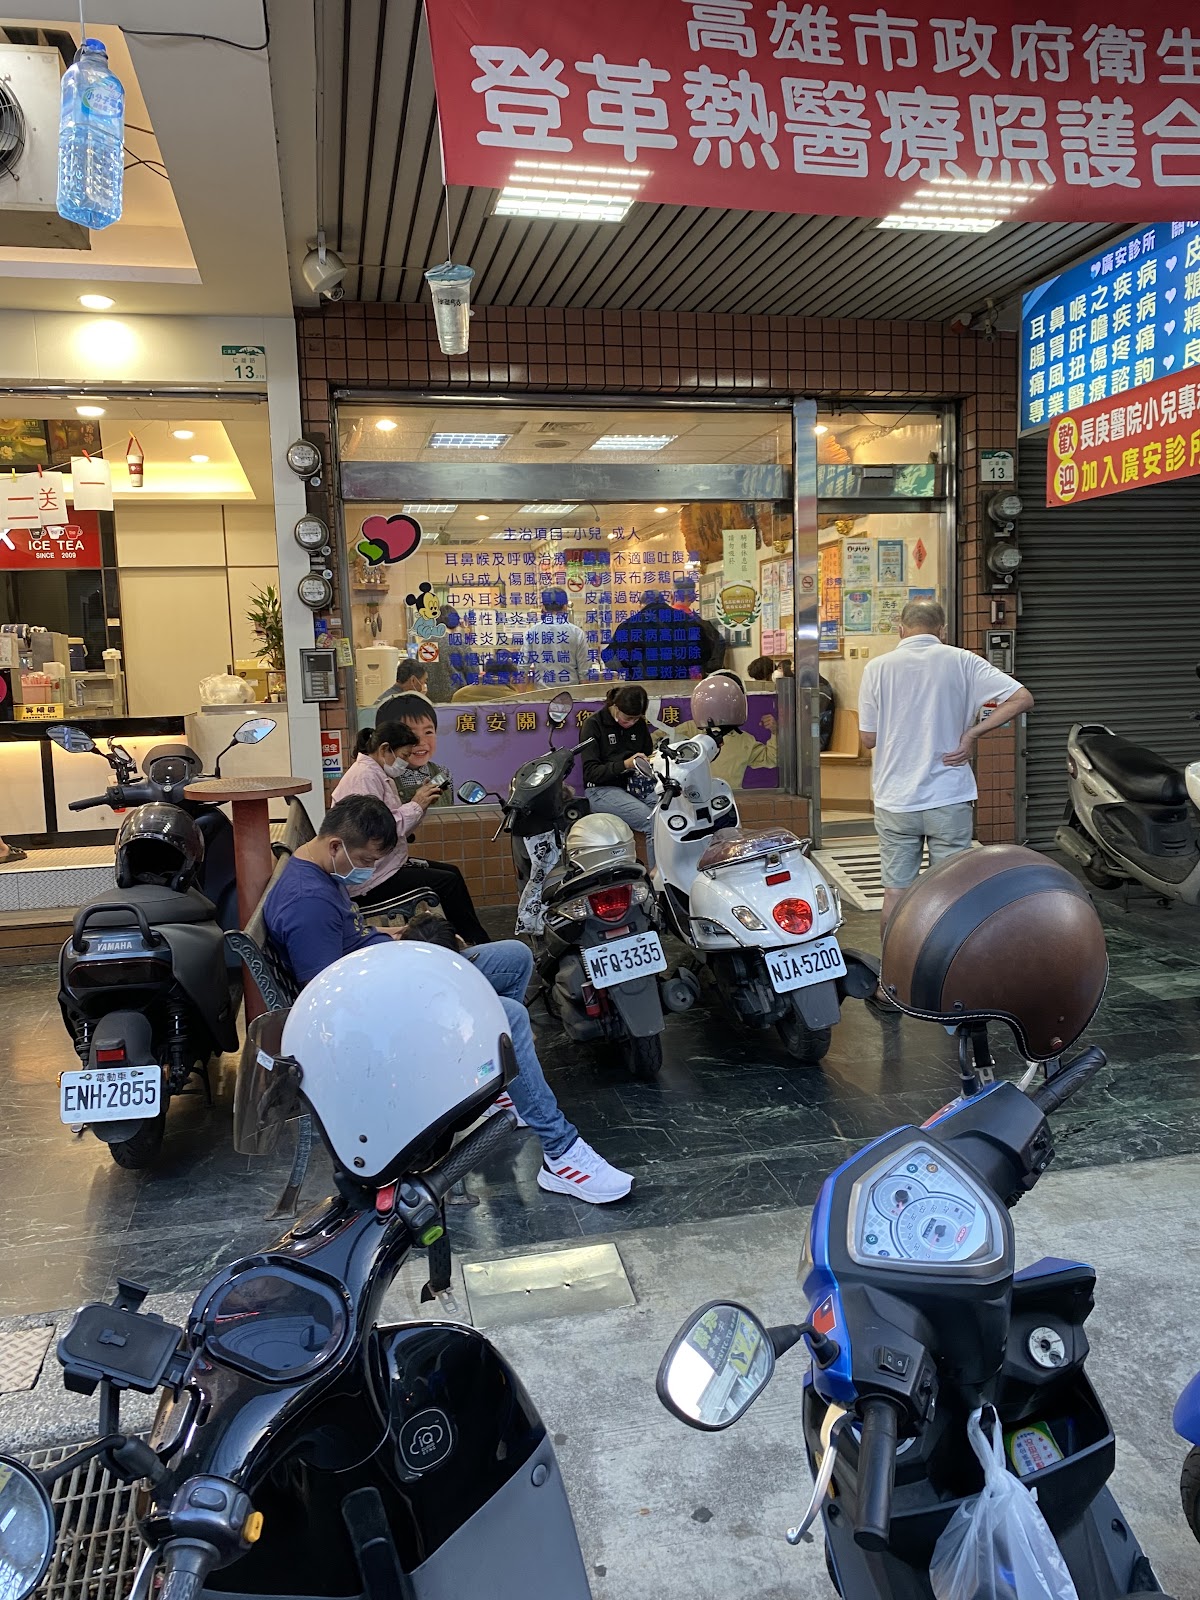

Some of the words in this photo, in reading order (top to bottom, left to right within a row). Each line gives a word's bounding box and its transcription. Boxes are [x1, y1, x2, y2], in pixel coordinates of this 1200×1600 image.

[686, 0, 1200, 85] 高雄市政府衛生
[471, 45, 1200, 190] 登革熱醫療照護合
[1101, 230, 1156, 276] 廣安診所
[1030, 258, 1157, 341] 耳鼻喉之疾病
[1029, 291, 1156, 371] 腸胃肝膽疾病
[1028, 323, 1156, 397] 痛風扭傷疼痛
[234, 365, 255, 379] 13
[1028, 357, 1155, 424] 專業醫療諮詢
[1080, 383, 1200, 450] 長庚醫院小兒專
[1058, 422, 1075, 496] 歡迎
[989, 467, 1005, 479] 13
[39, 487, 59, 511] 送
[612, 526, 641, 541] 成人
[28, 540, 50, 550] ICE
[56, 540, 84, 550] TEA
[445, 551, 567, 567] 耳鼻喉及呼吸治療
[583, 550, 700, 566] 不適嘔吐腹
[446, 572, 567, 587] 小兒成人傷風感冒
[446, 592, 568, 607] 中外耳炎暈眩
[447, 609, 569, 628] 慢性鼻炎鼻過敏
[448, 631, 570, 646] 咽喉炎及扁桃腺炎
[323, 743, 338, 753] 保全
[97, 941, 133, 951] YAMAHA
[96, 1071, 127, 1082] 電動車
[418, 1432, 434, 1447] iQ
